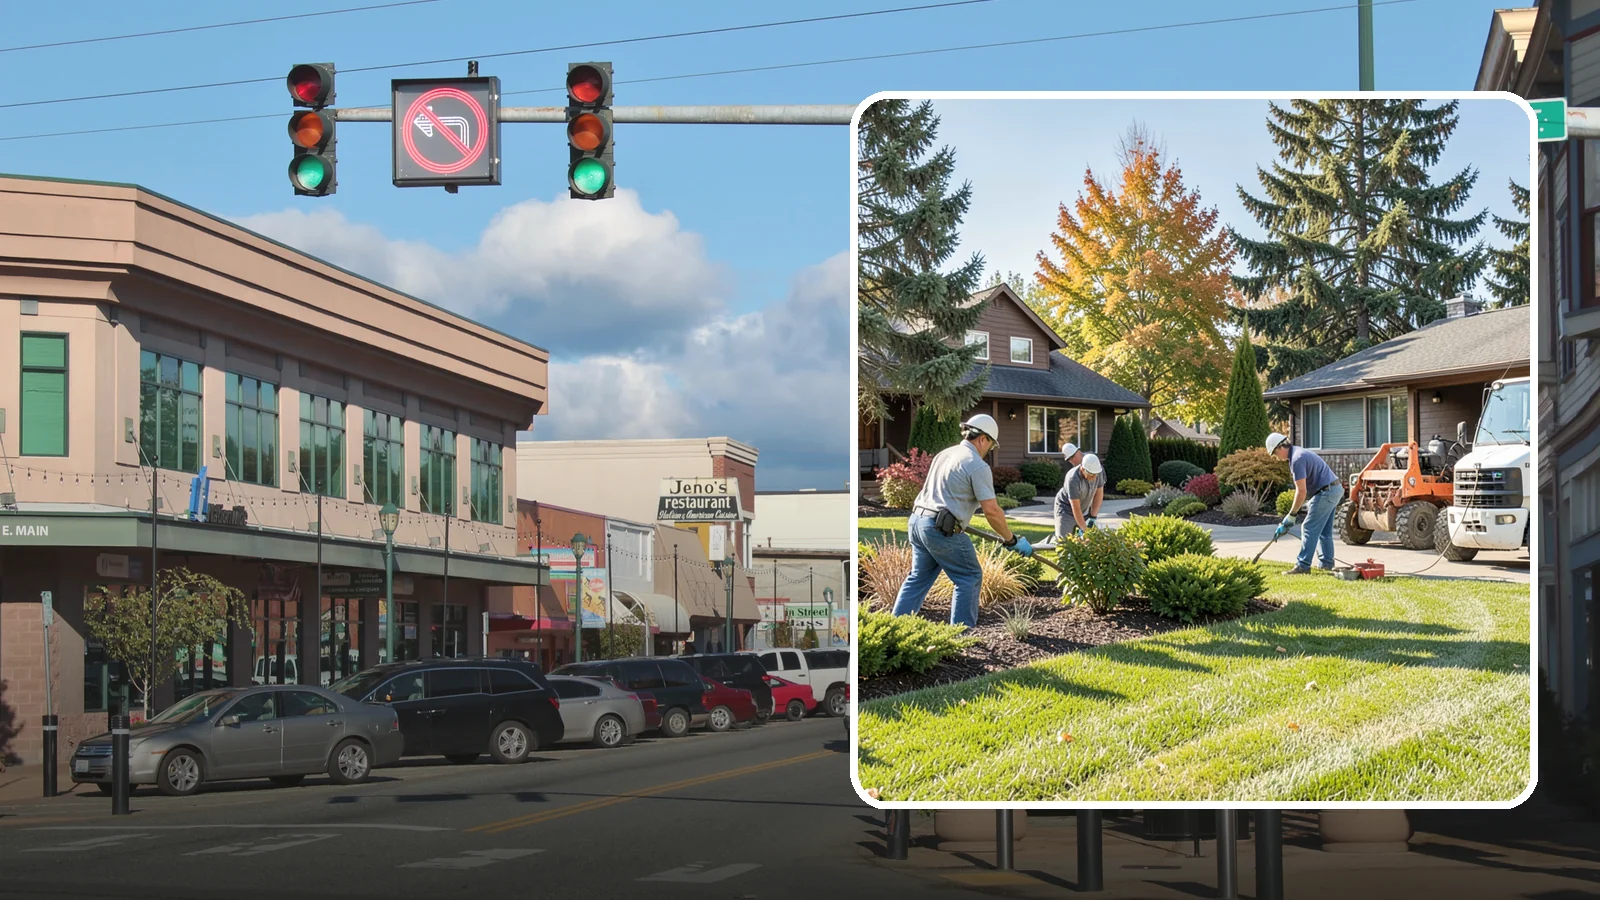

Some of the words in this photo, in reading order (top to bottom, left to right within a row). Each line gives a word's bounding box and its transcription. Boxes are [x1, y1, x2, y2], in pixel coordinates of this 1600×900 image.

[669, 480, 727, 494] Jeno's
[665, 496, 731, 509] restaurant
[659, 510, 681, 519] Italian
[686, 510, 714, 519] American
[714, 509, 738, 519] Cuisine
[2, 525, 13, 536] E.
[16, 525, 49, 536] MAIN
[797, 607, 828, 617] Street
[790, 619, 823, 627] lass
